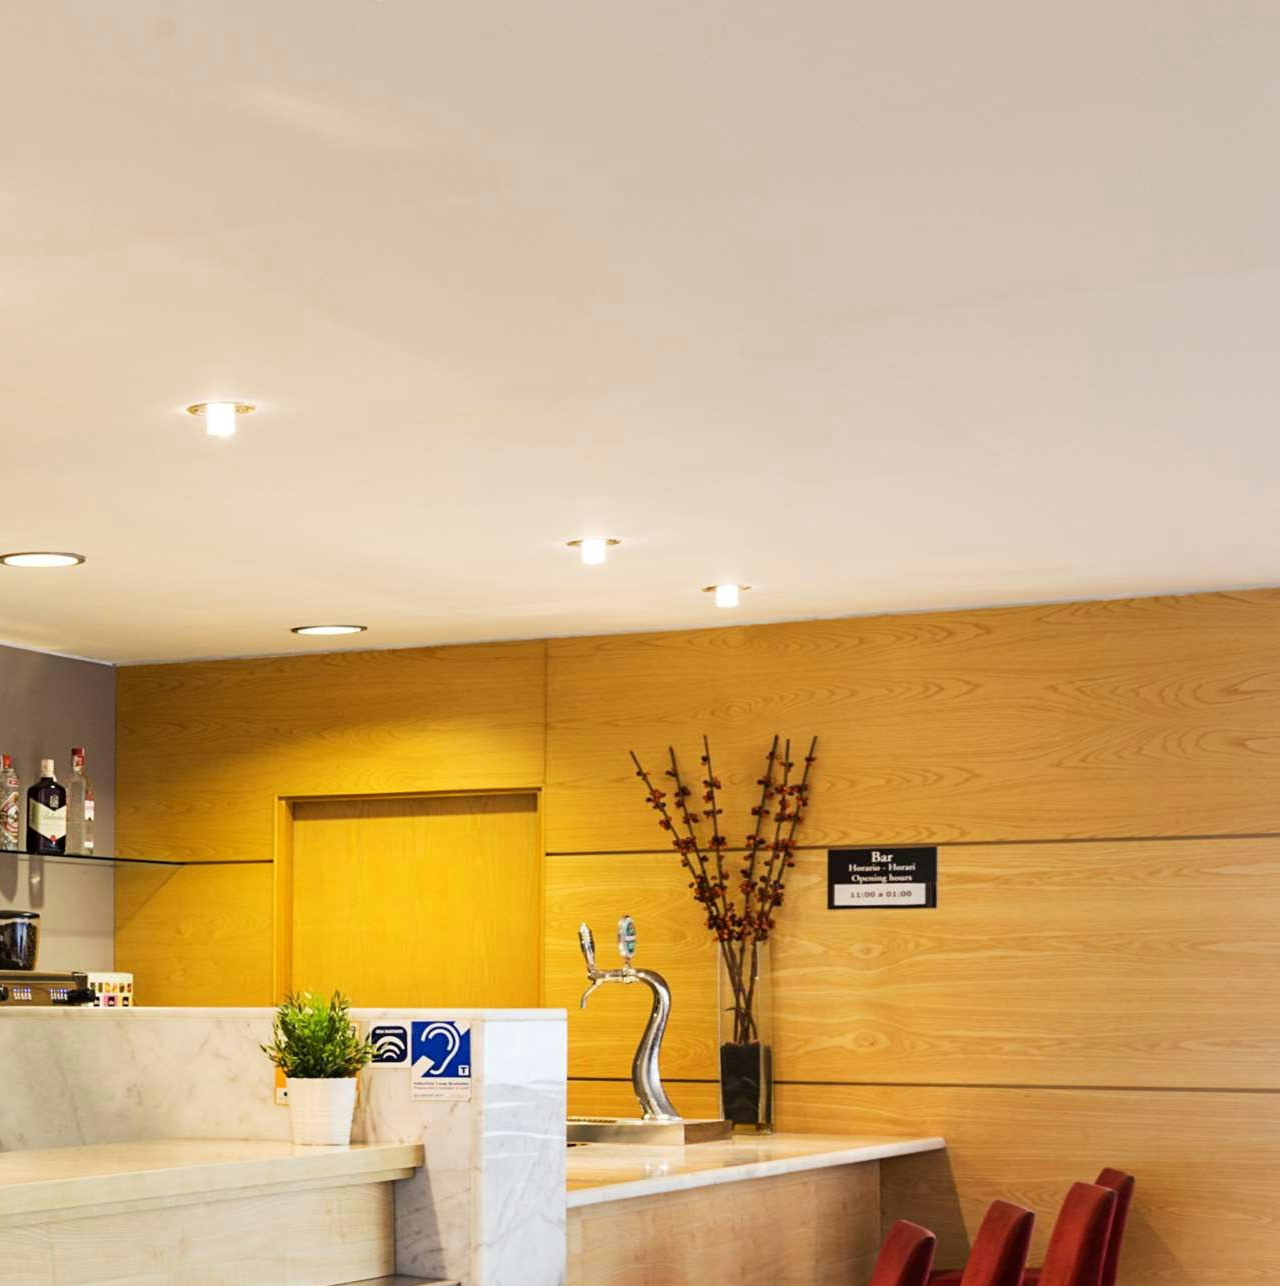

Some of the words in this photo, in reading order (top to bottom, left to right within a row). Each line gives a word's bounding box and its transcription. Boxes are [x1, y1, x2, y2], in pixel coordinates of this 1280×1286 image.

[871, 851, 894, 862] Bar
[848, 863, 881, 872] Horario
[888, 862, 916, 871] Horari
[851, 874, 887, 884] Opening
[888, 873, 913, 881] hours
